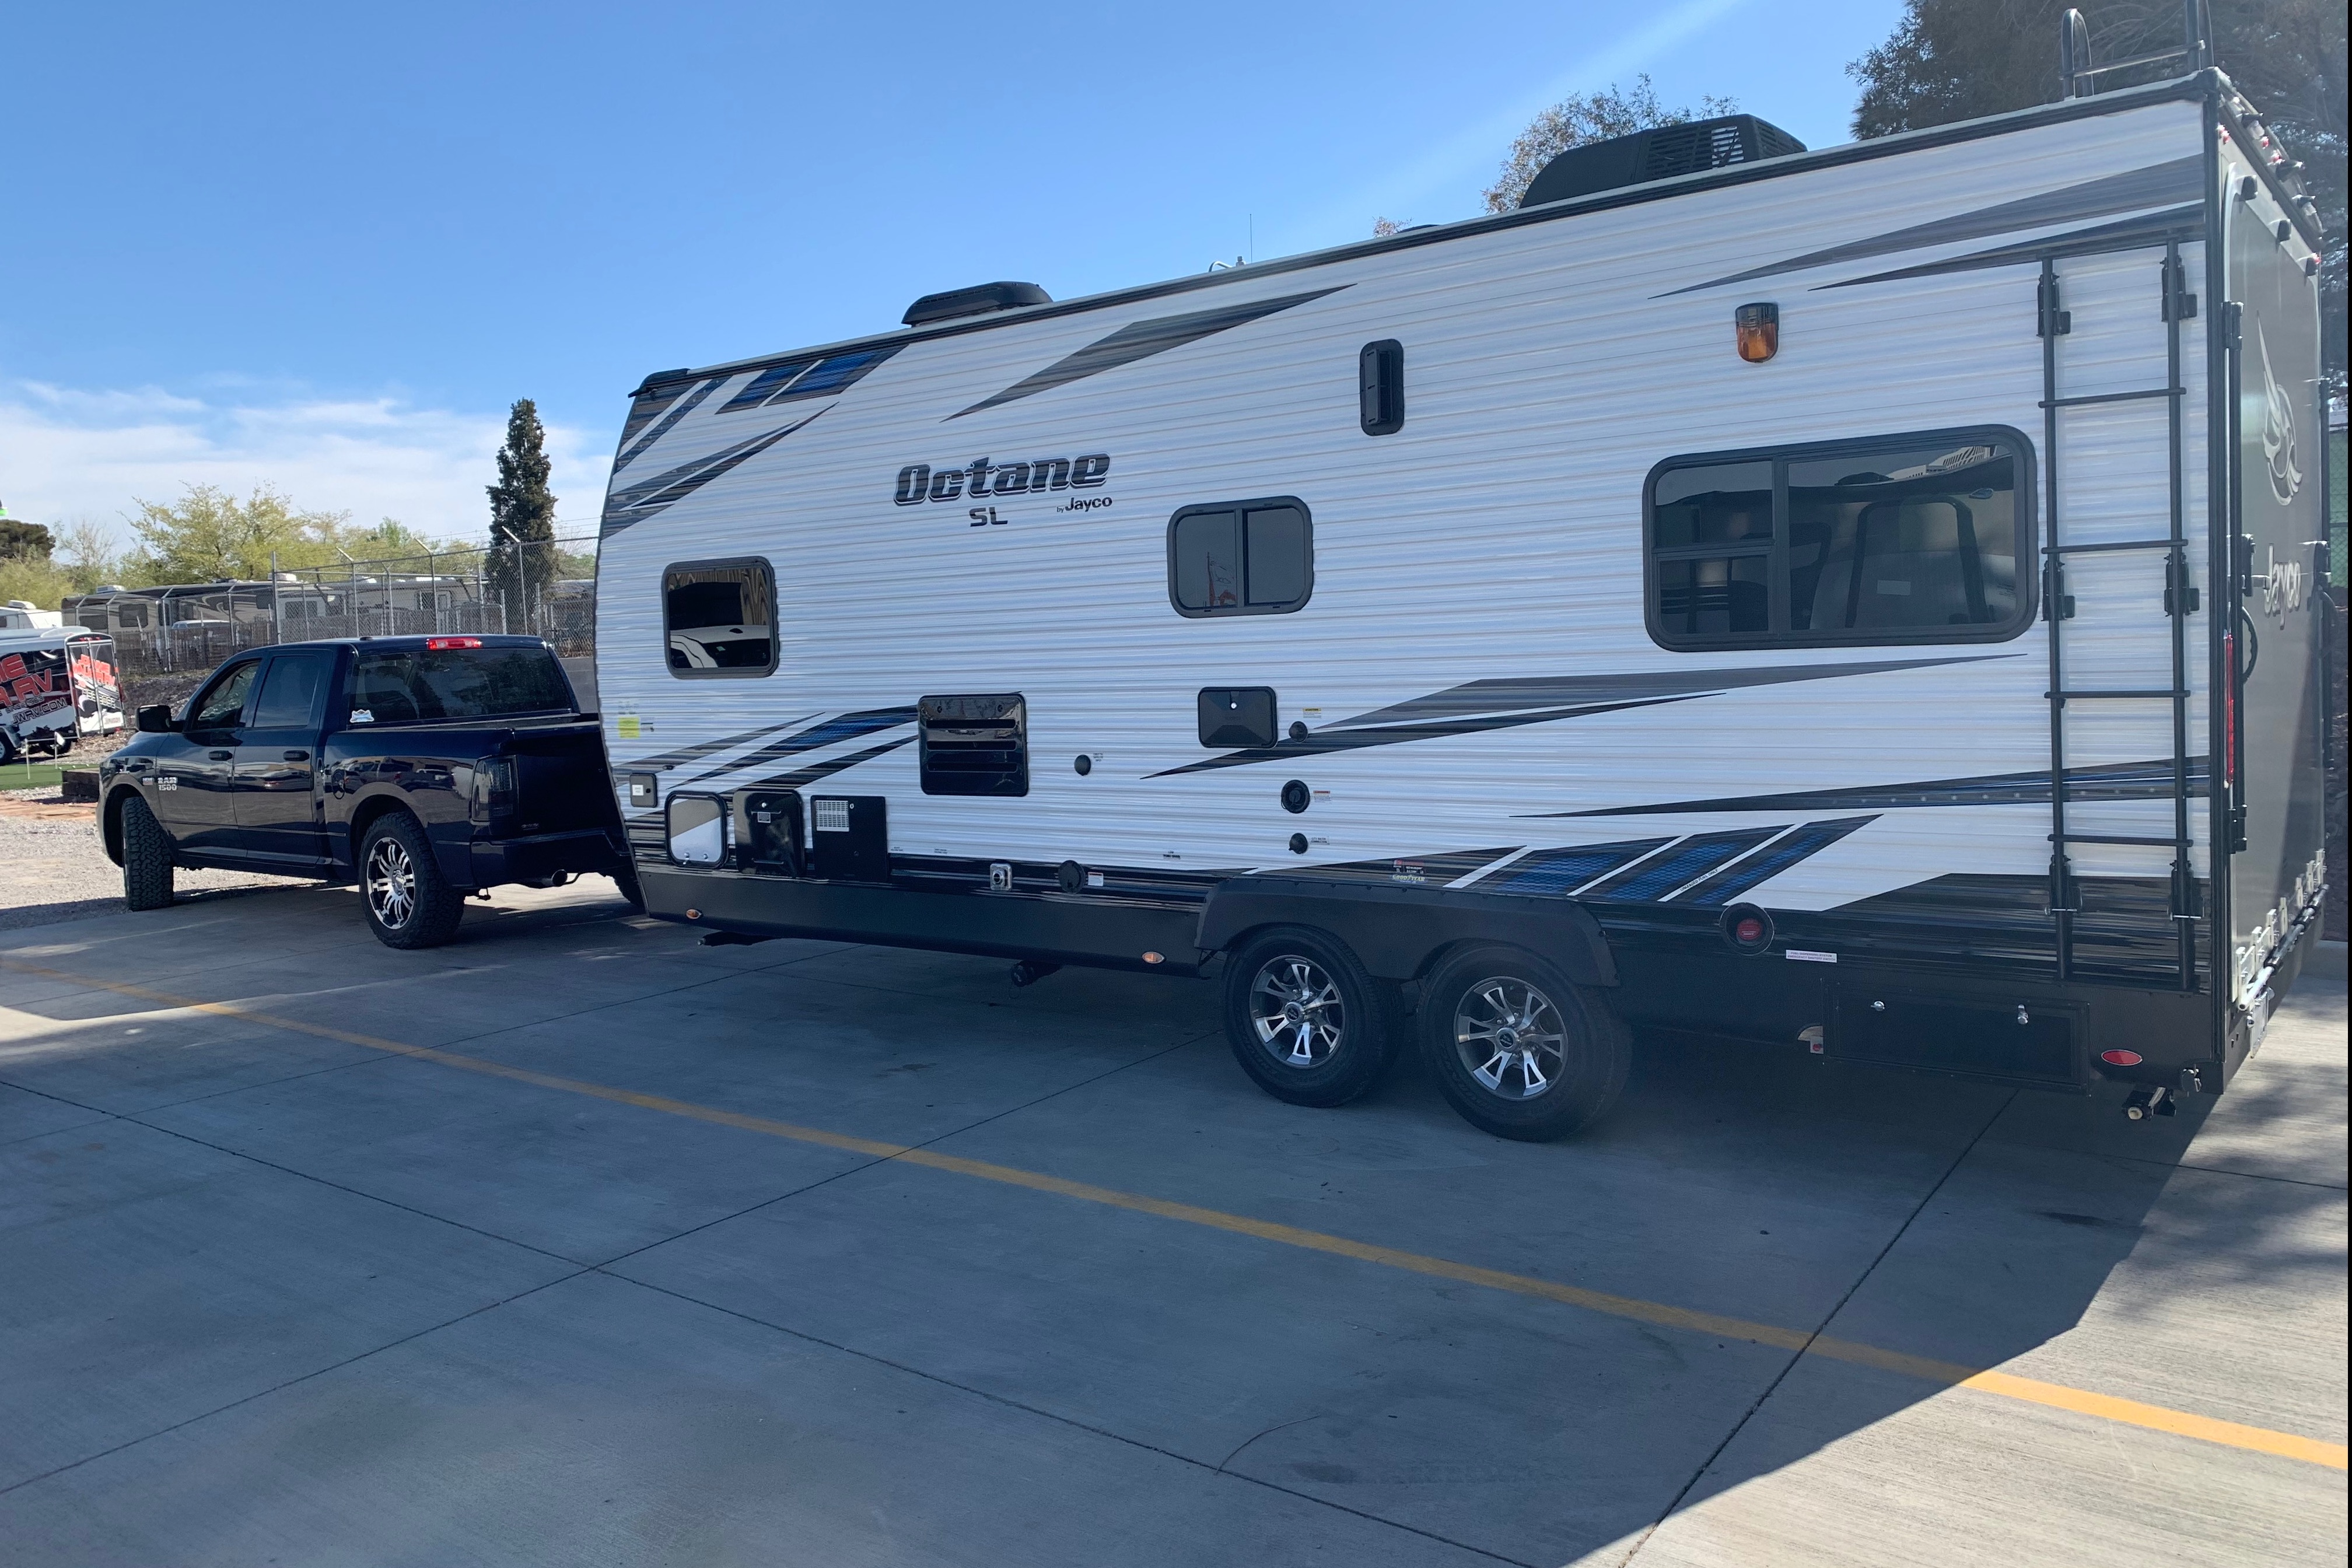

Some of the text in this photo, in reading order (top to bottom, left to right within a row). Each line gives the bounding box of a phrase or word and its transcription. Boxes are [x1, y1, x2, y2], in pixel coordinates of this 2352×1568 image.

[894, 452, 1111, 506] Octane
[1065, 497, 1113, 512] Jayco
[969, 507, 1008, 527] SL
[2264, 543, 2301, 631] Jayco
[1680, 879, 1699, 892] UNLEADED
